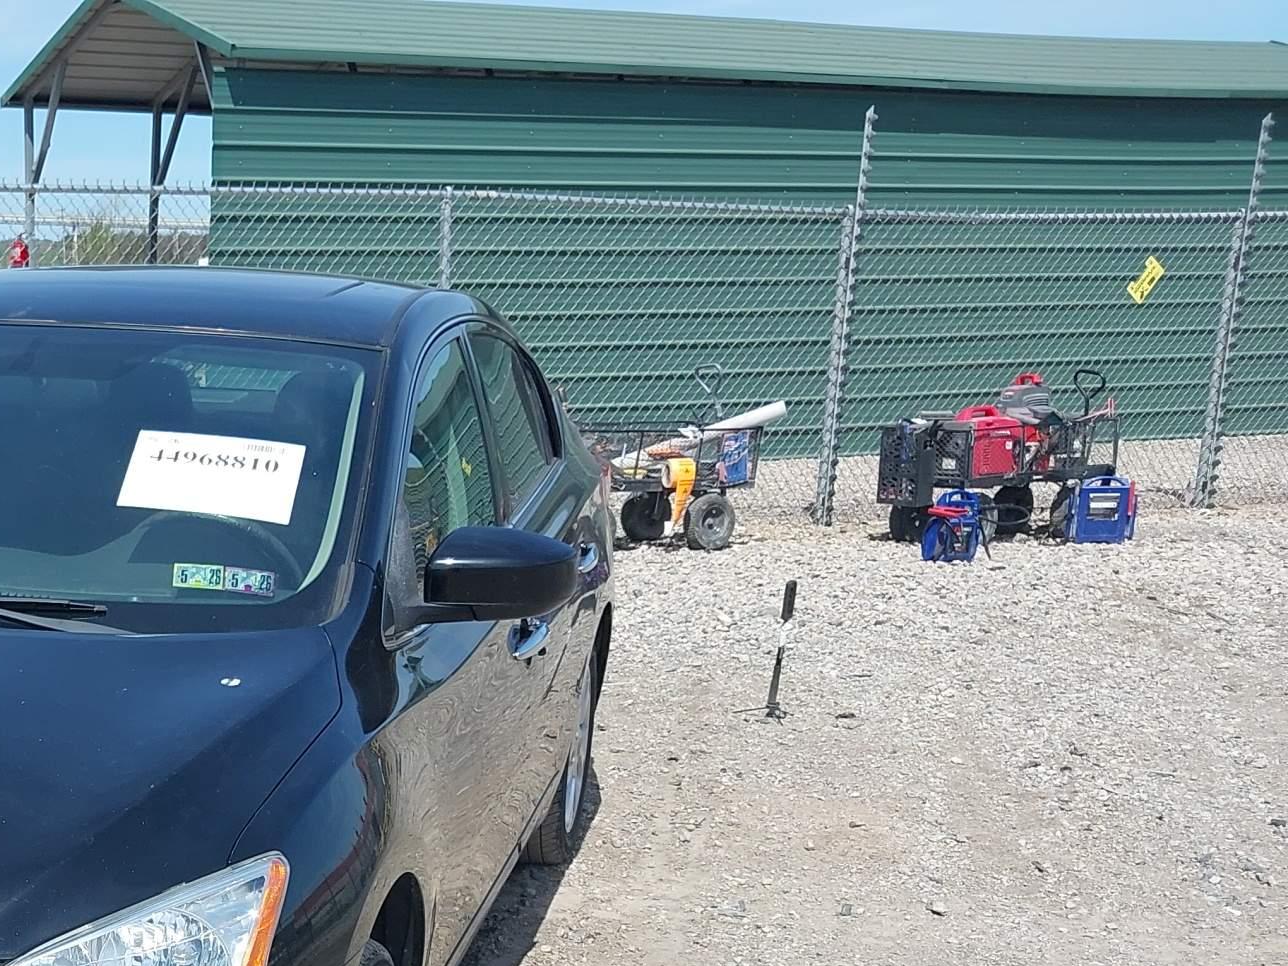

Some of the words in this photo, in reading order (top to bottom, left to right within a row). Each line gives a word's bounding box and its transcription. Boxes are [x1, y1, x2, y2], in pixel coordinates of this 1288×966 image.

[150, 449, 279, 472] 44968810
[180, 569, 189, 584] 5
[231, 573, 240, 588] 5
